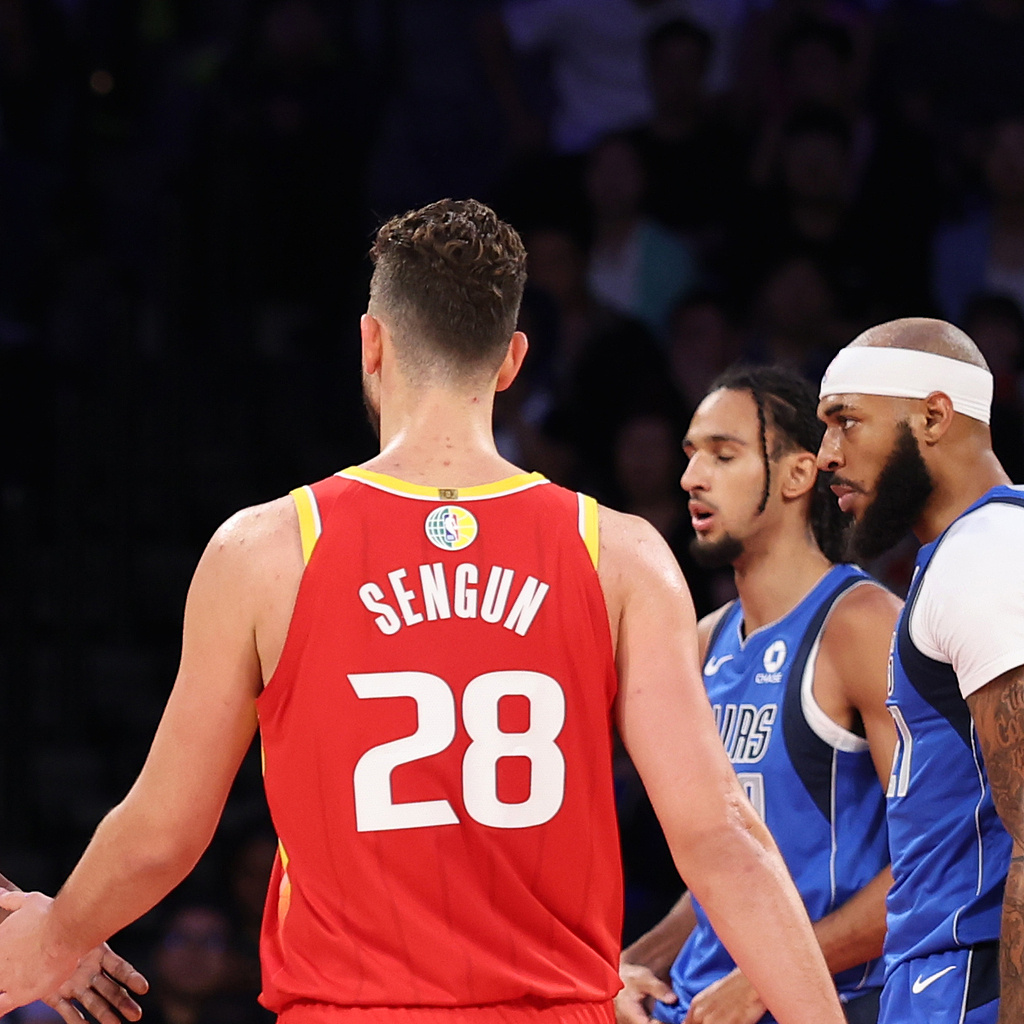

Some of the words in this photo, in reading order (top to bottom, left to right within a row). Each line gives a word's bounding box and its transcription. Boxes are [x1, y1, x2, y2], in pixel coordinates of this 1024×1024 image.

[358, 562, 550, 637] SENGUN
[755, 672, 782, 685] CHASE
[346, 670, 566, 832] 28
